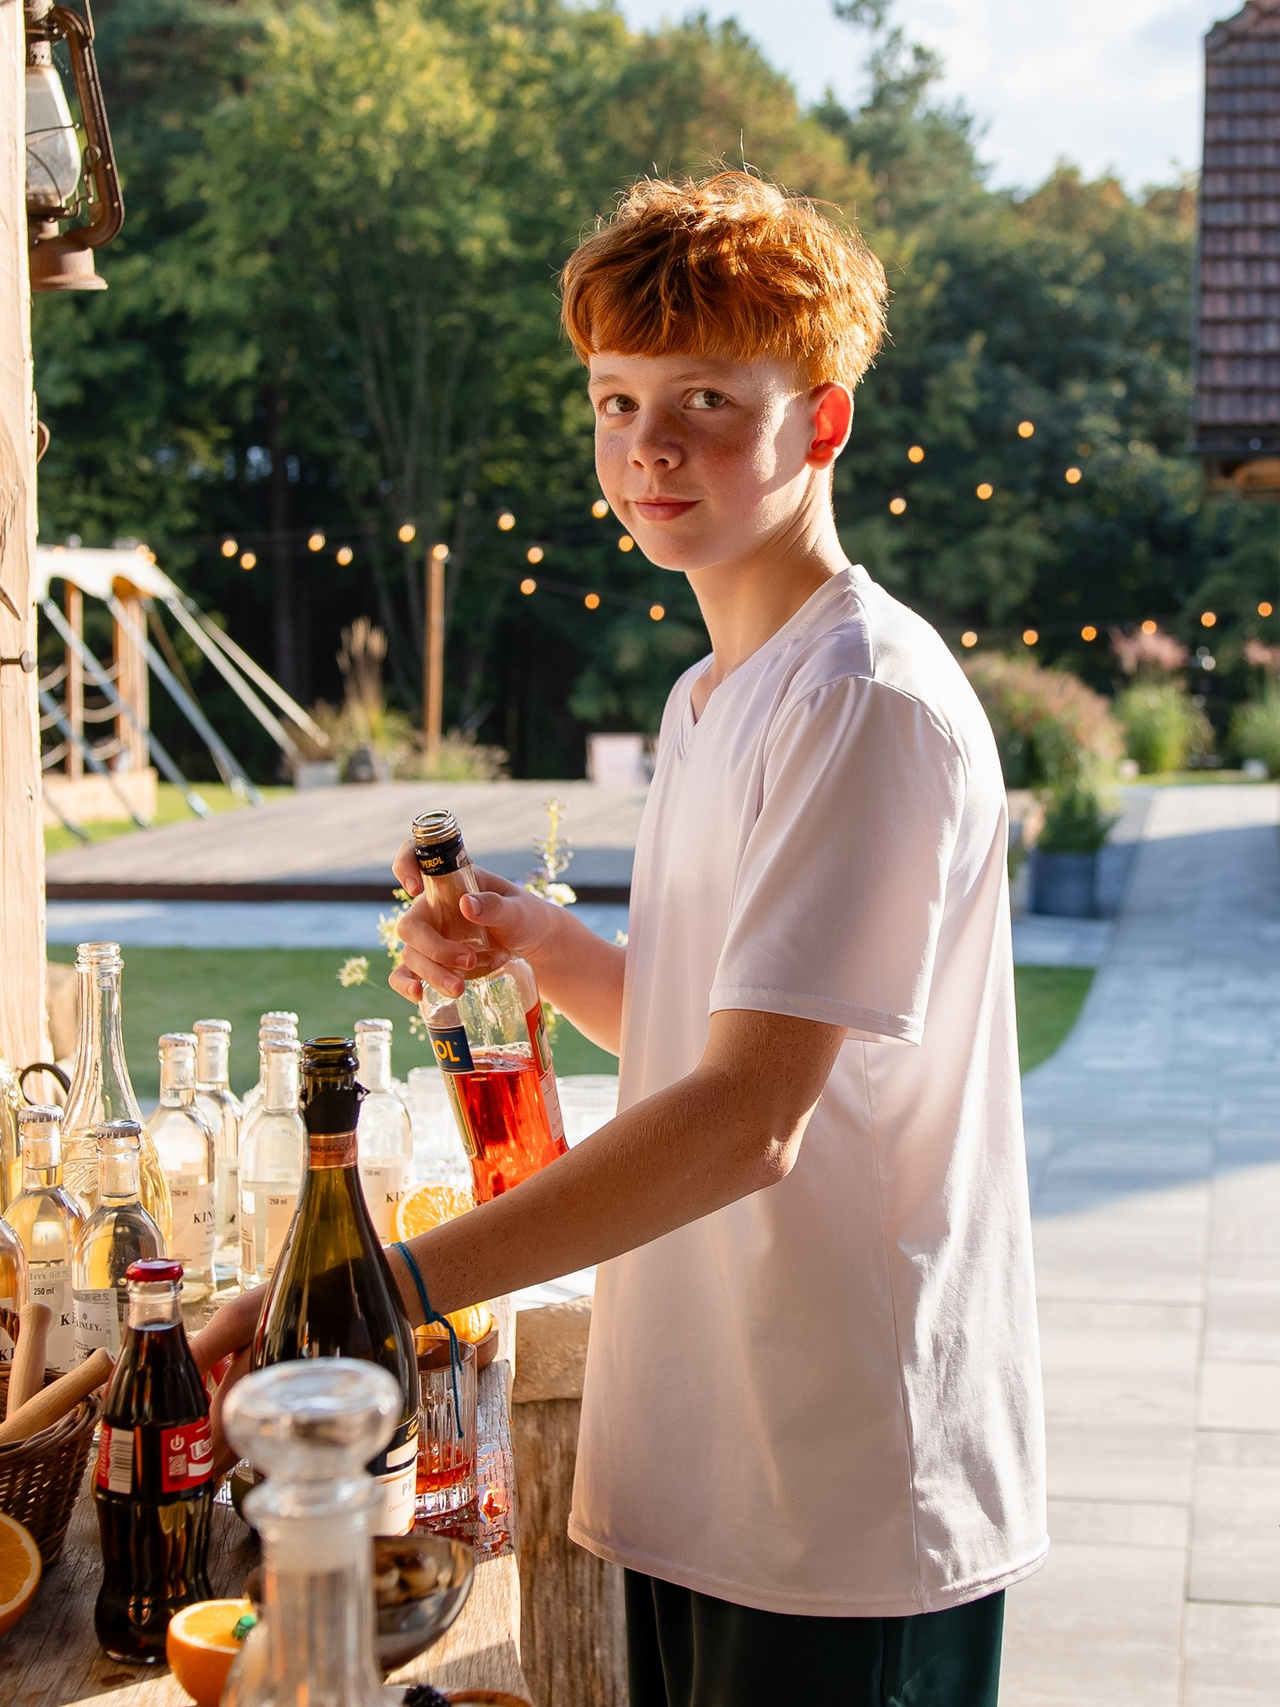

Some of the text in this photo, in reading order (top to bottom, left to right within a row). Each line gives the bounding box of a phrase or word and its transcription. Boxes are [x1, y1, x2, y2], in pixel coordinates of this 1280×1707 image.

[433, 1039, 460, 1062] OL
[33, 1286, 55, 1296] 250 ml
